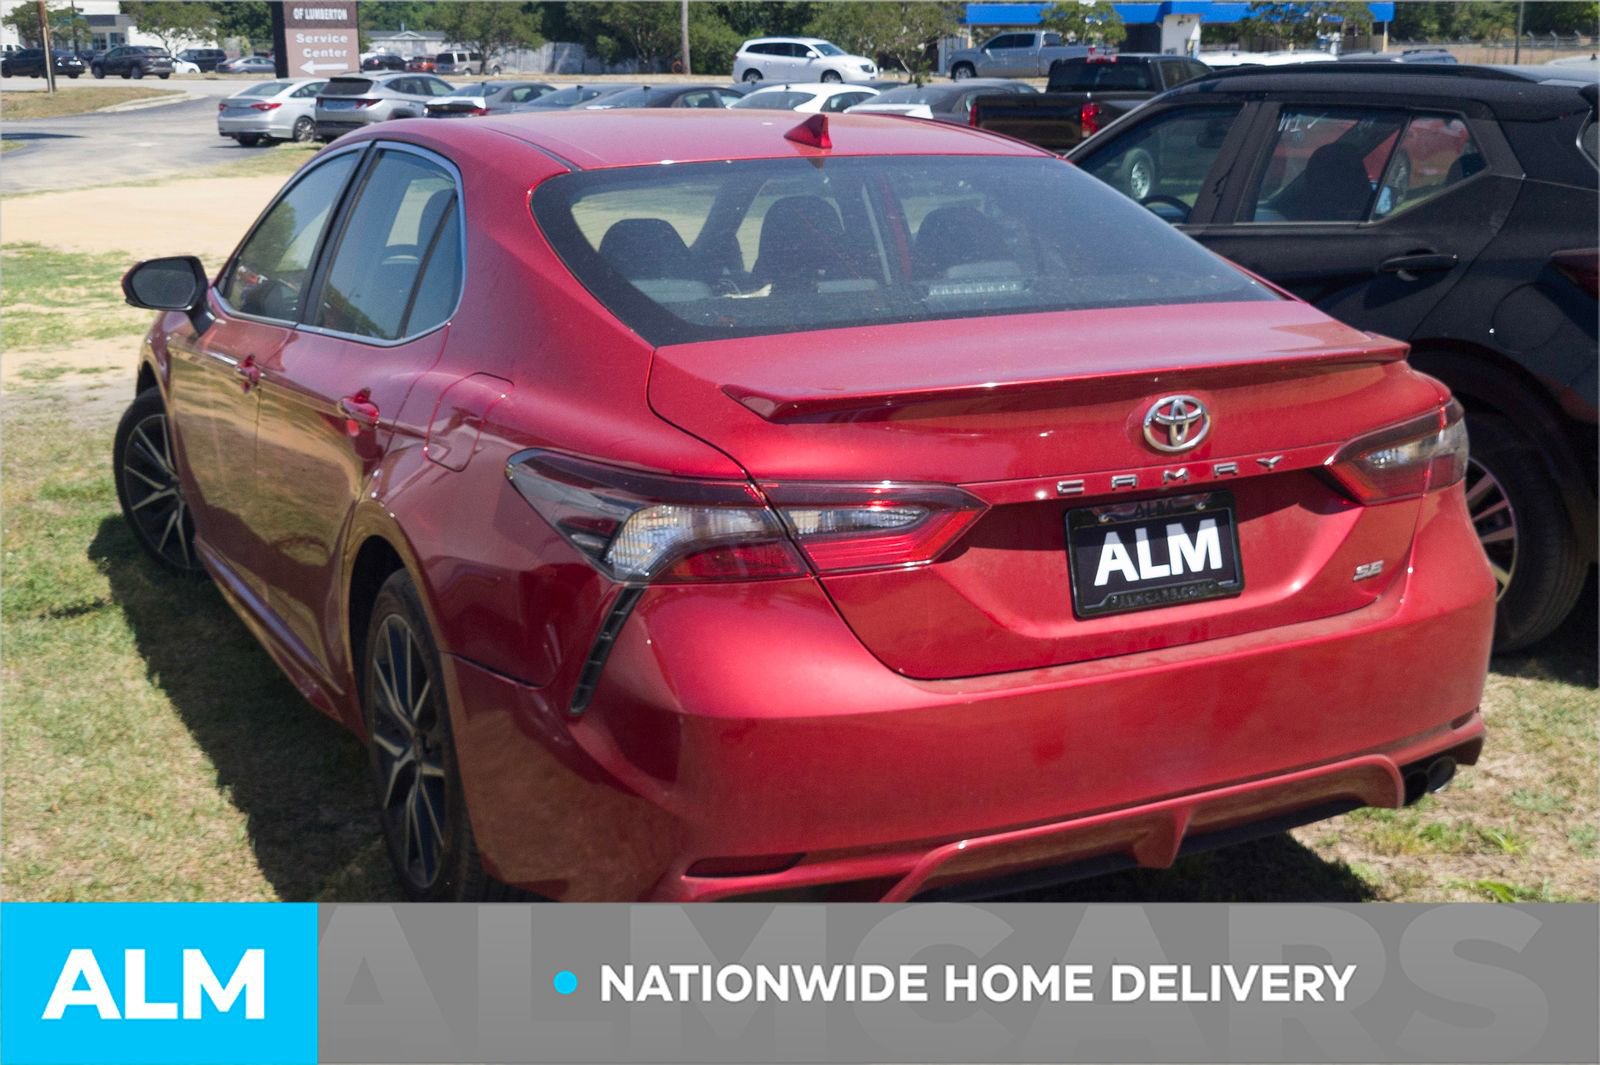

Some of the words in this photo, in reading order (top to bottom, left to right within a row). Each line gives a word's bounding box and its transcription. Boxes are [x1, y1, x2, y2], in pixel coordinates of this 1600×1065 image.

[293, 8, 304, 20] OF
[304, 8, 348, 20] LUMBERTON
[295, 33, 348, 43] Service
[303, 48, 347, 58] Center
[1057, 455, 1283, 494] CAMRY
[1094, 519, 1223, 587] ALM
[1353, 560, 1384, 581] SE
